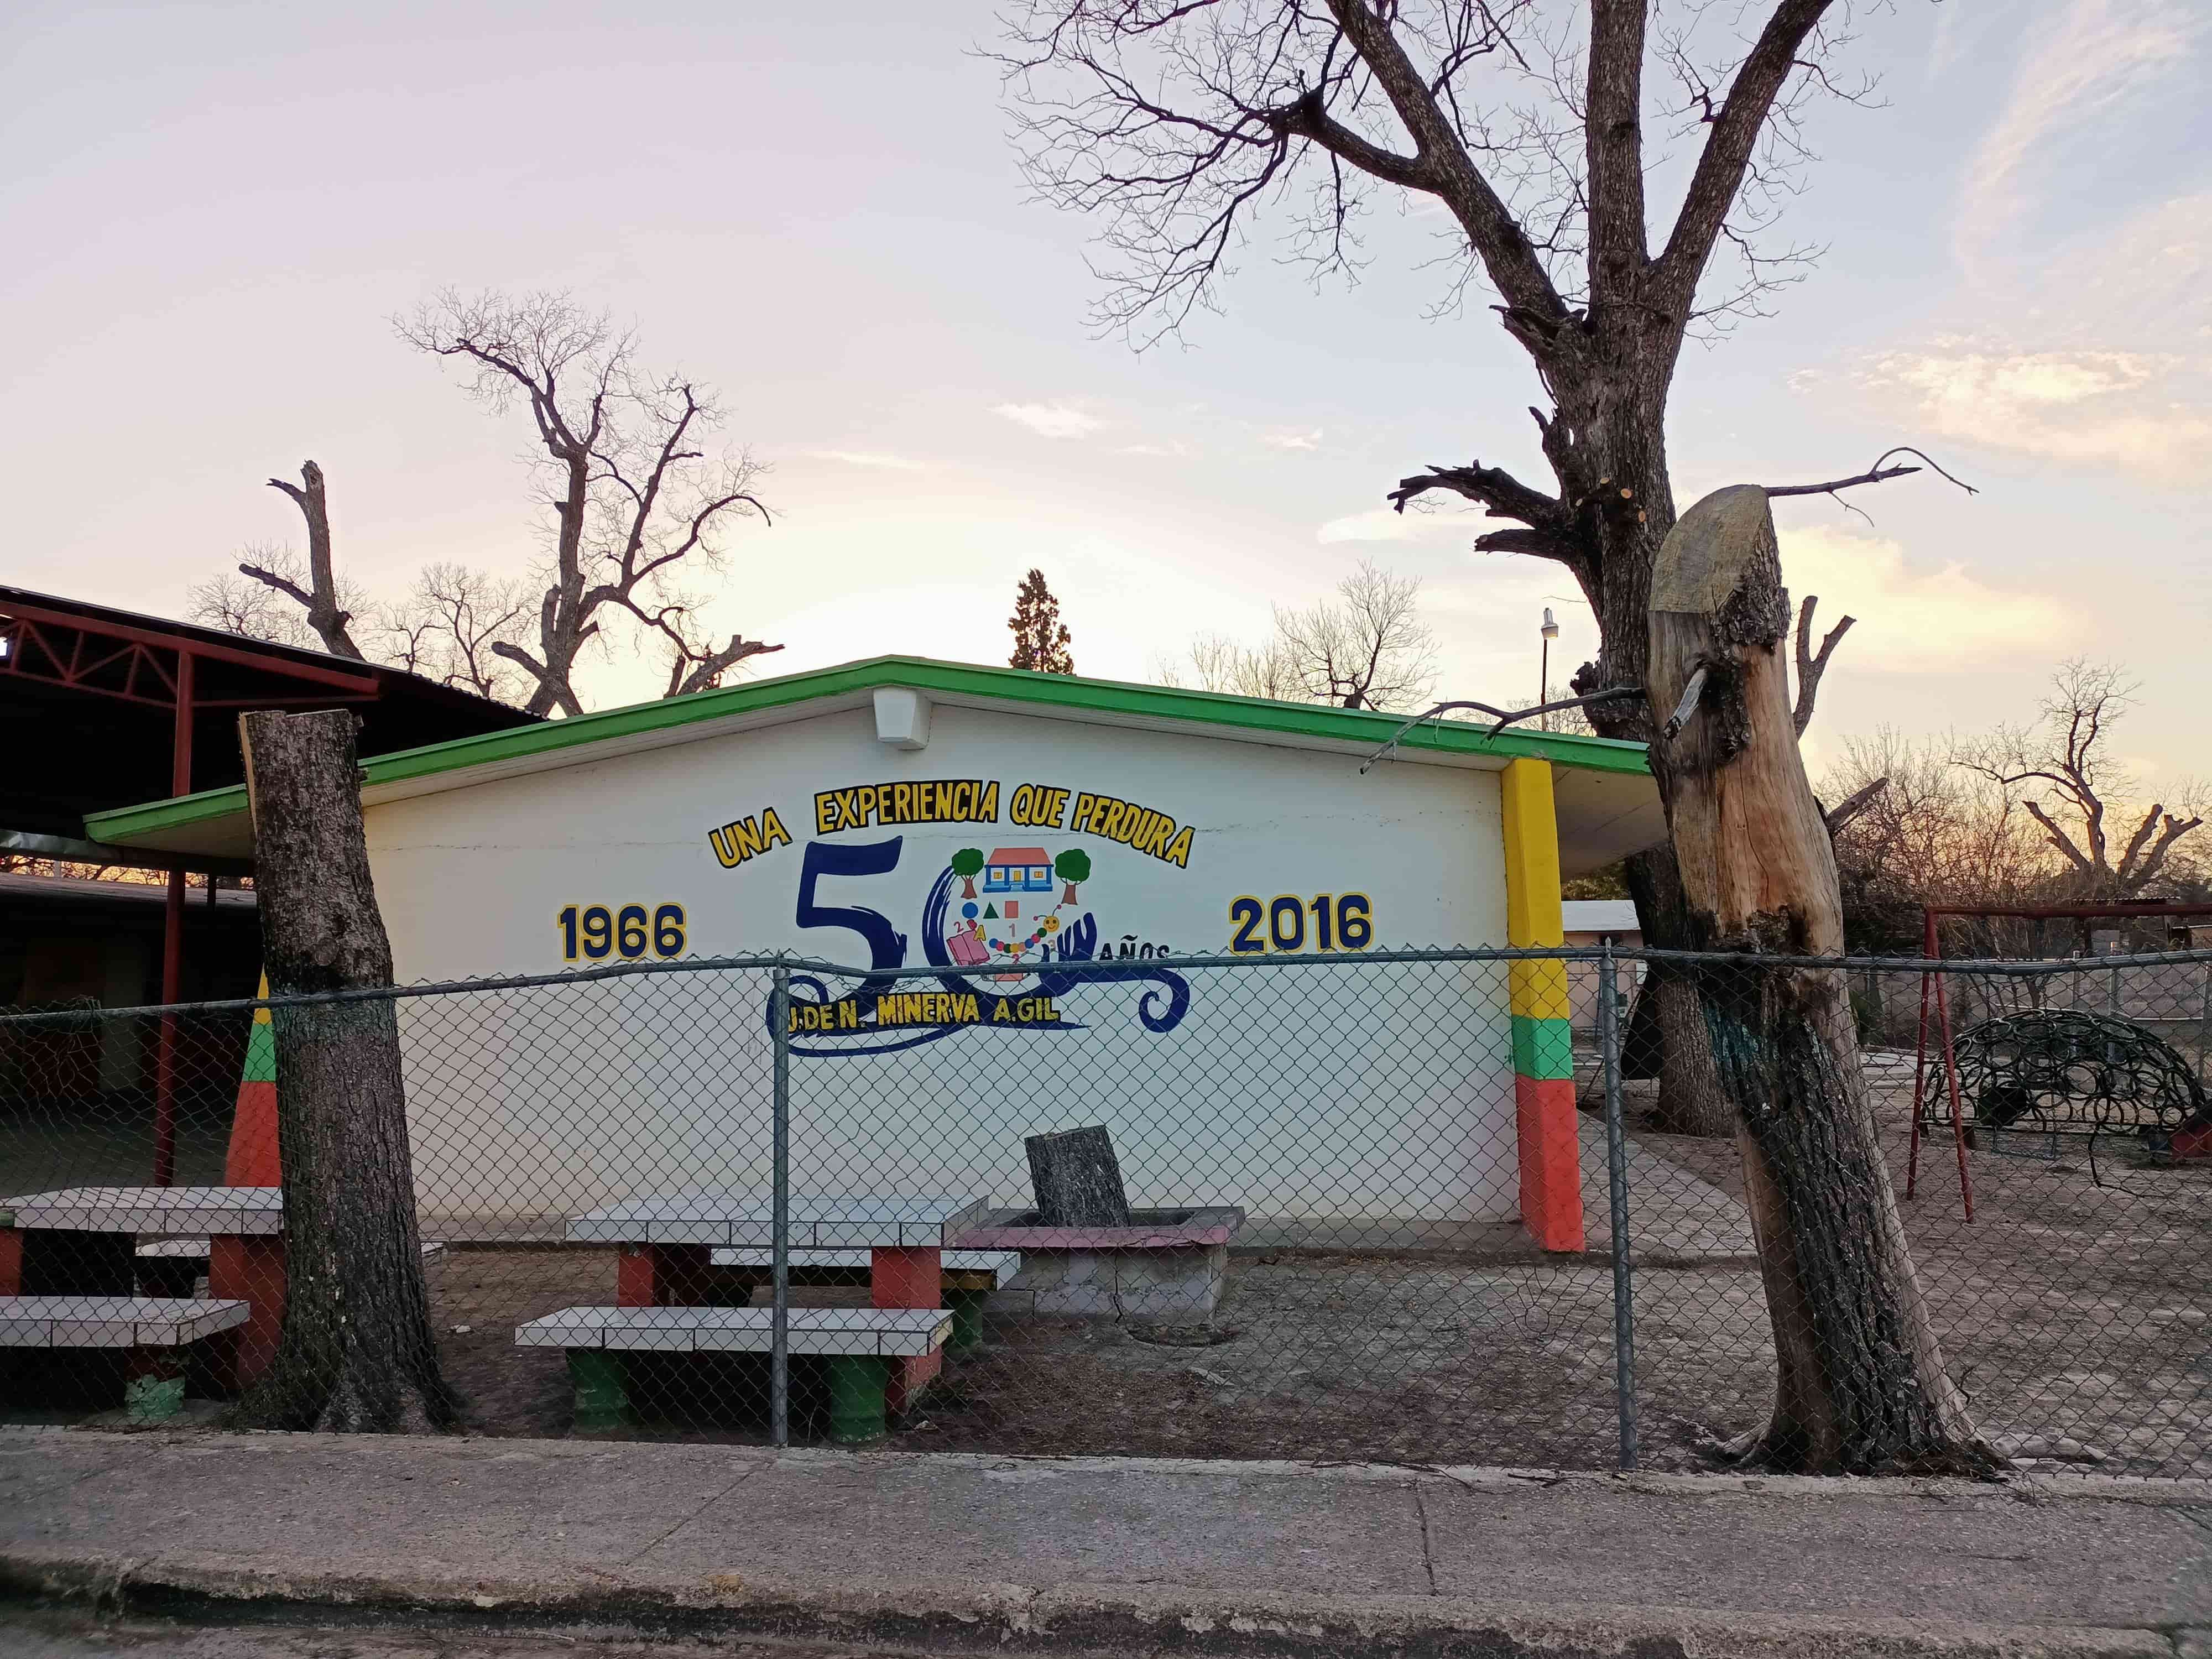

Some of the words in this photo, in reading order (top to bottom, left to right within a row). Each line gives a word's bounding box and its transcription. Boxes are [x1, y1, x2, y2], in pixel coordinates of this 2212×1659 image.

[708, 806, 793, 869] UNA
[813, 779, 1000, 837] EXPERIENCIA
[1010, 782, 1072, 829] QUE
[1070, 791, 1196, 869] PERDURA
[557, 902, 688, 962] 1966
[973, 925, 987, 942] A
[1008, 922, 1016, 938] 1
[1229, 891, 1374, 956] 2016
[1099, 934, 1170, 961] AÑOS
[877, 993, 980, 1027] MINERVA
